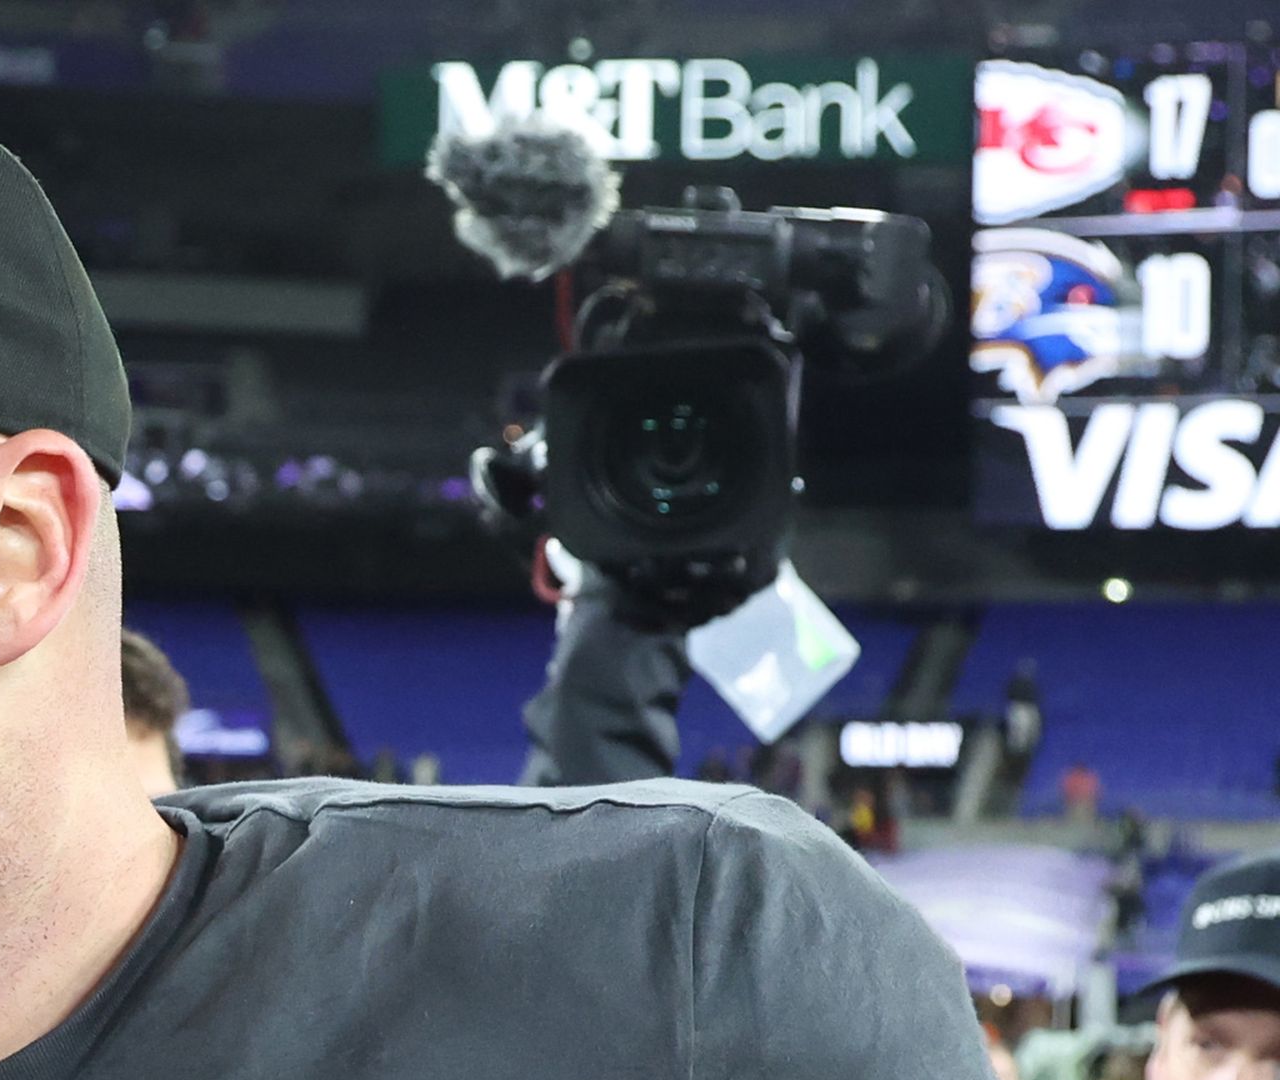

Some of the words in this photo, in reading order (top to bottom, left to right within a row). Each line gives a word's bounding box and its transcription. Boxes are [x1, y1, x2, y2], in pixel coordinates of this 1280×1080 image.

[432, 59, 680, 160] M&T
[680, 57, 918, 160] Bank
[1143, 74, 1212, 180] 17
[1138, 251, 1211, 359] 10
